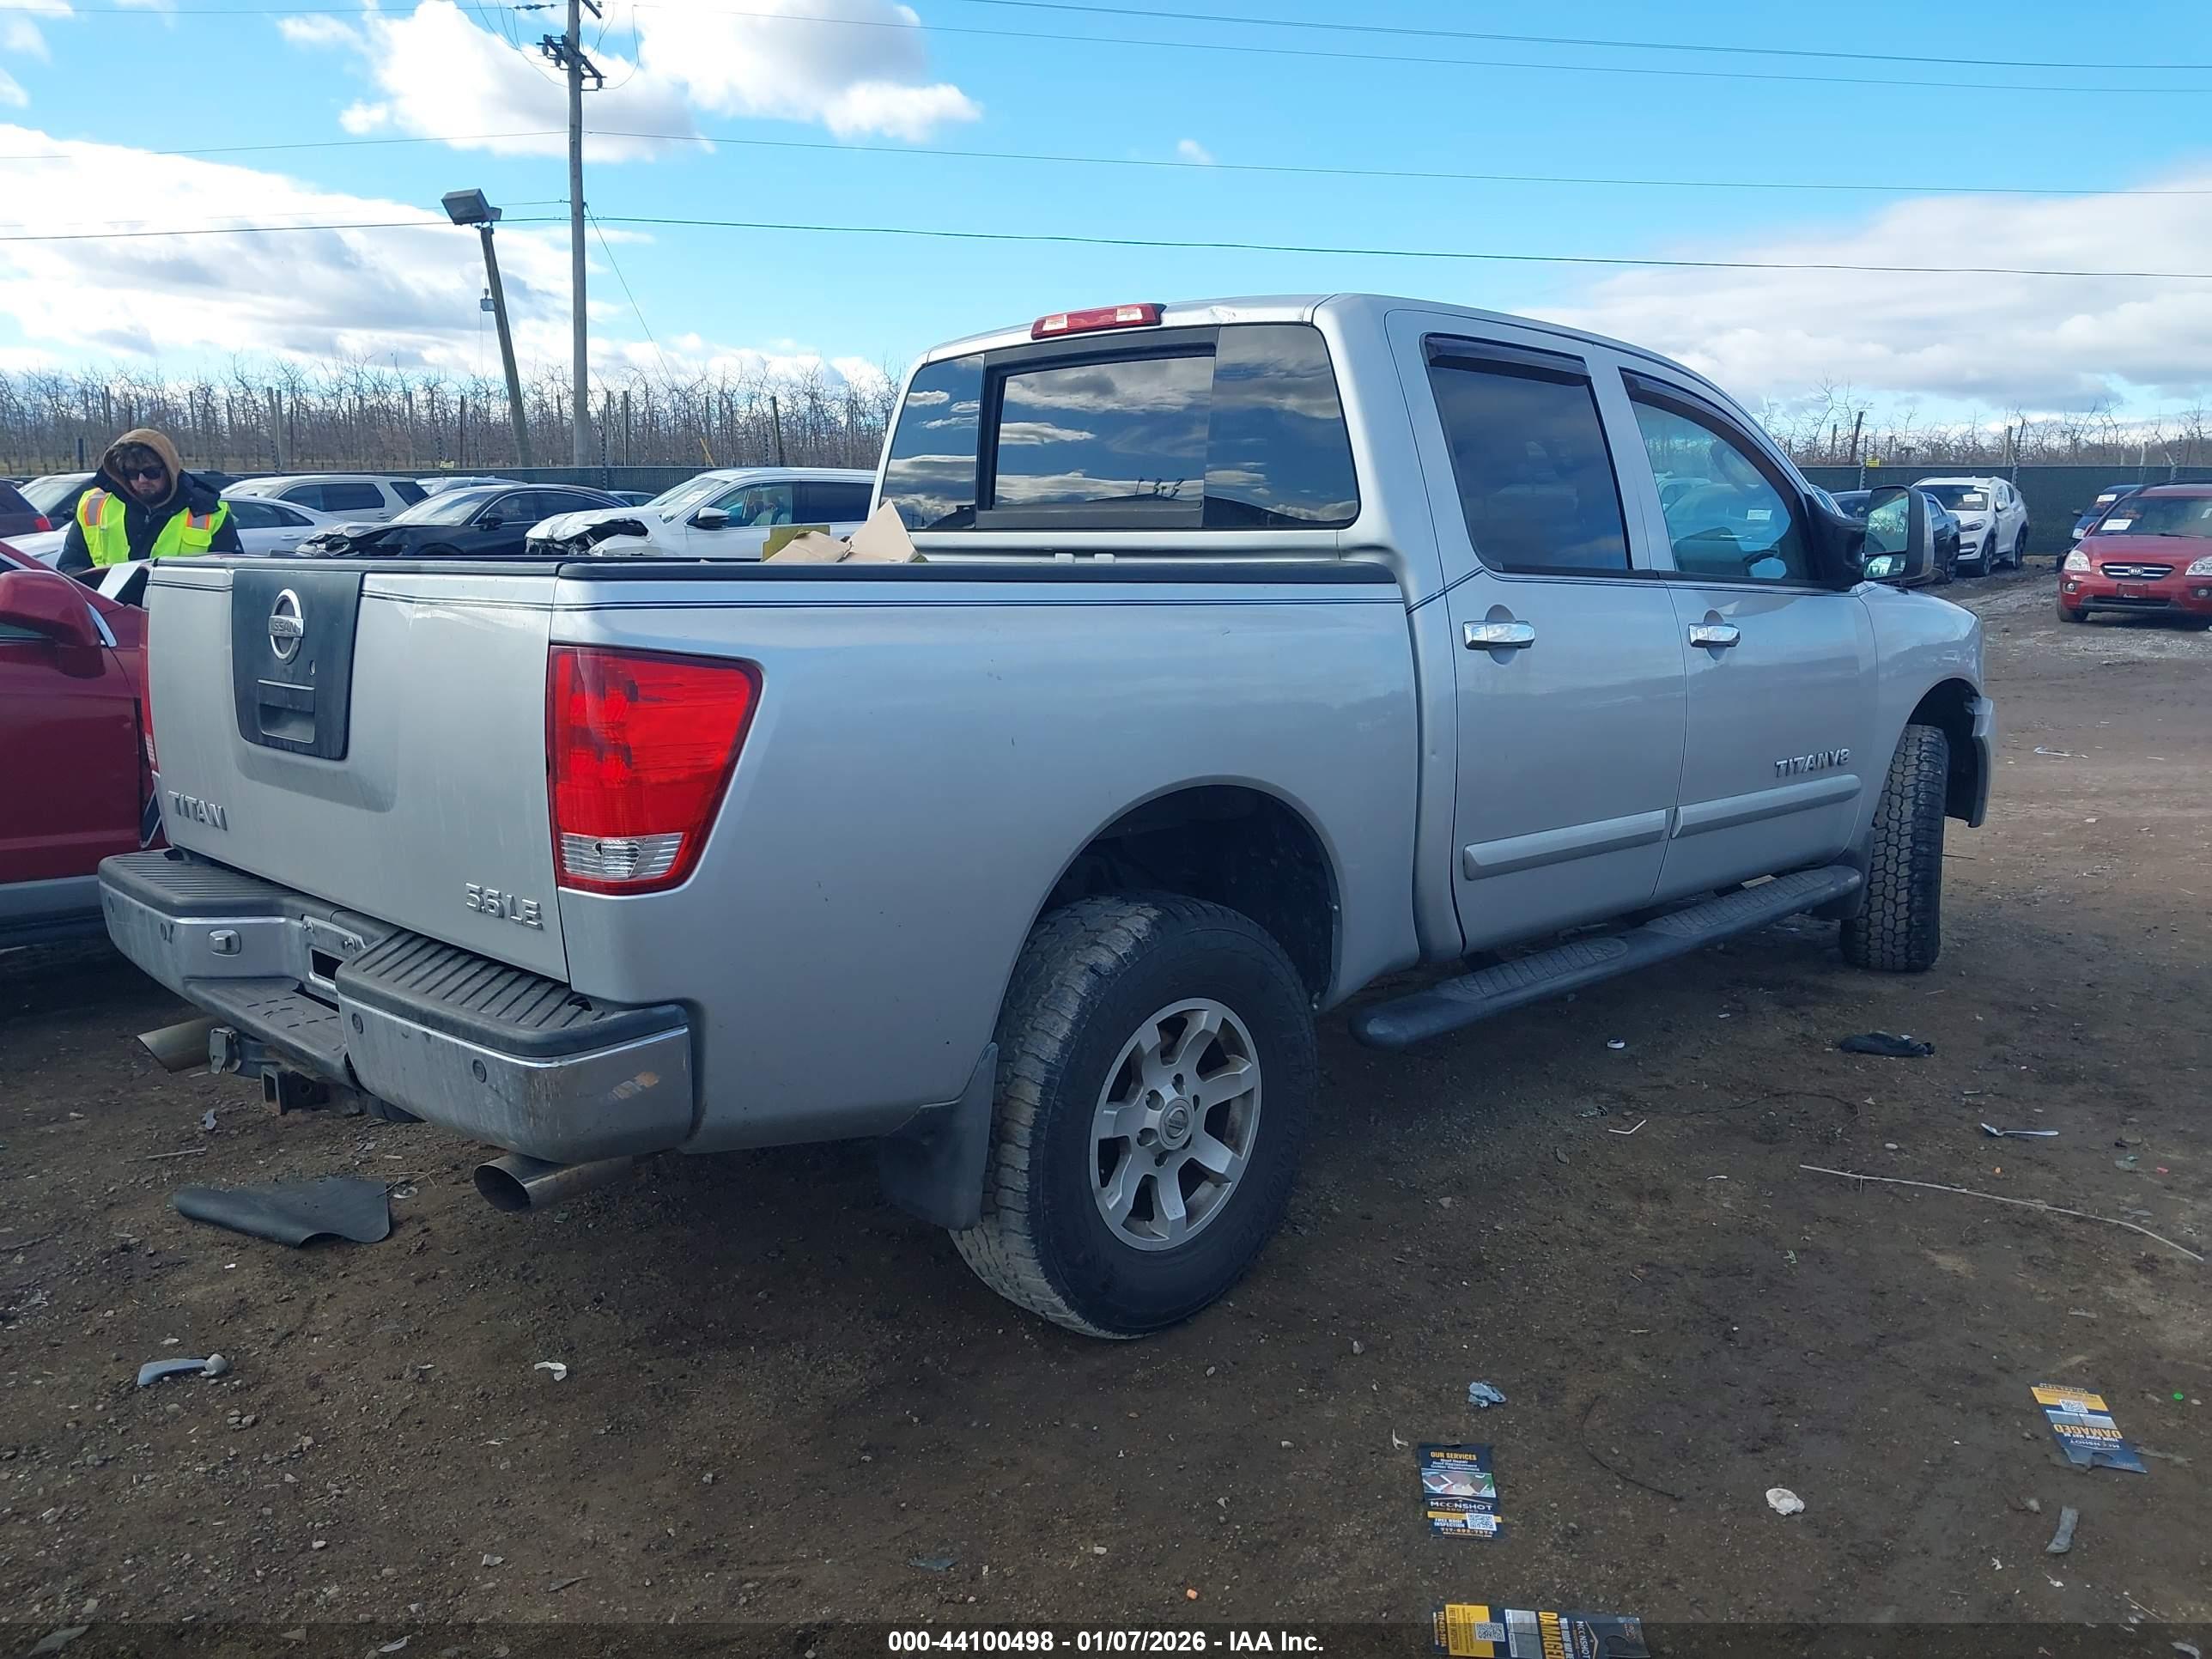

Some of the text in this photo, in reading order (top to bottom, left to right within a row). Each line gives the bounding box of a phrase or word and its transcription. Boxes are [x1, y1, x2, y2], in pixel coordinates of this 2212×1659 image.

[168, 790, 228, 831] TITAN
[2053, 1424, 2124, 1439] DAMAGED
[1446, 1452, 1478, 1461] SERVICES
